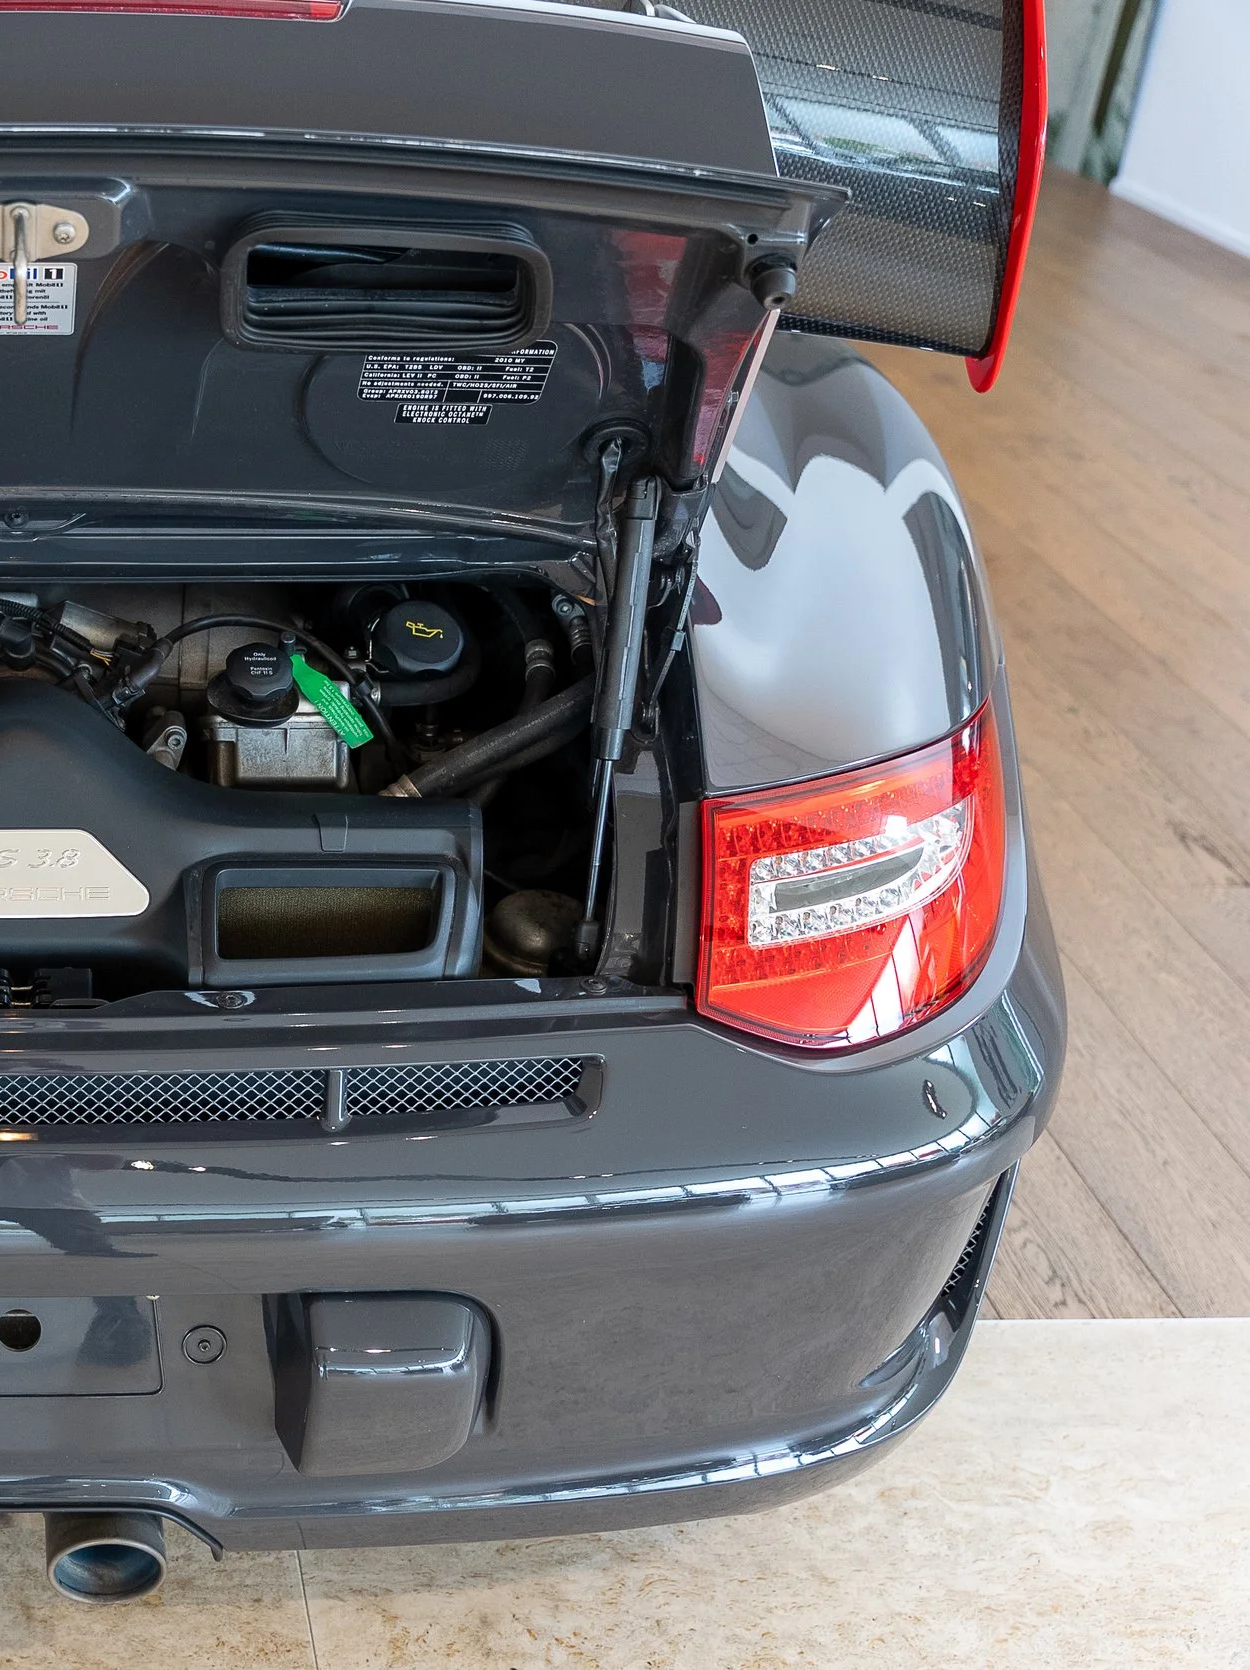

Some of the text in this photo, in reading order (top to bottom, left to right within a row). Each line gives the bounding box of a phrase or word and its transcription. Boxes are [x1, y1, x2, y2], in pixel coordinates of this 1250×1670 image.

[44, 268, 64, 280] 1
[509, 348, 555, 356] FORMATION
[316, 702, 346, 737] ATTENTION
[28, 848, 81, 869] 3.8
